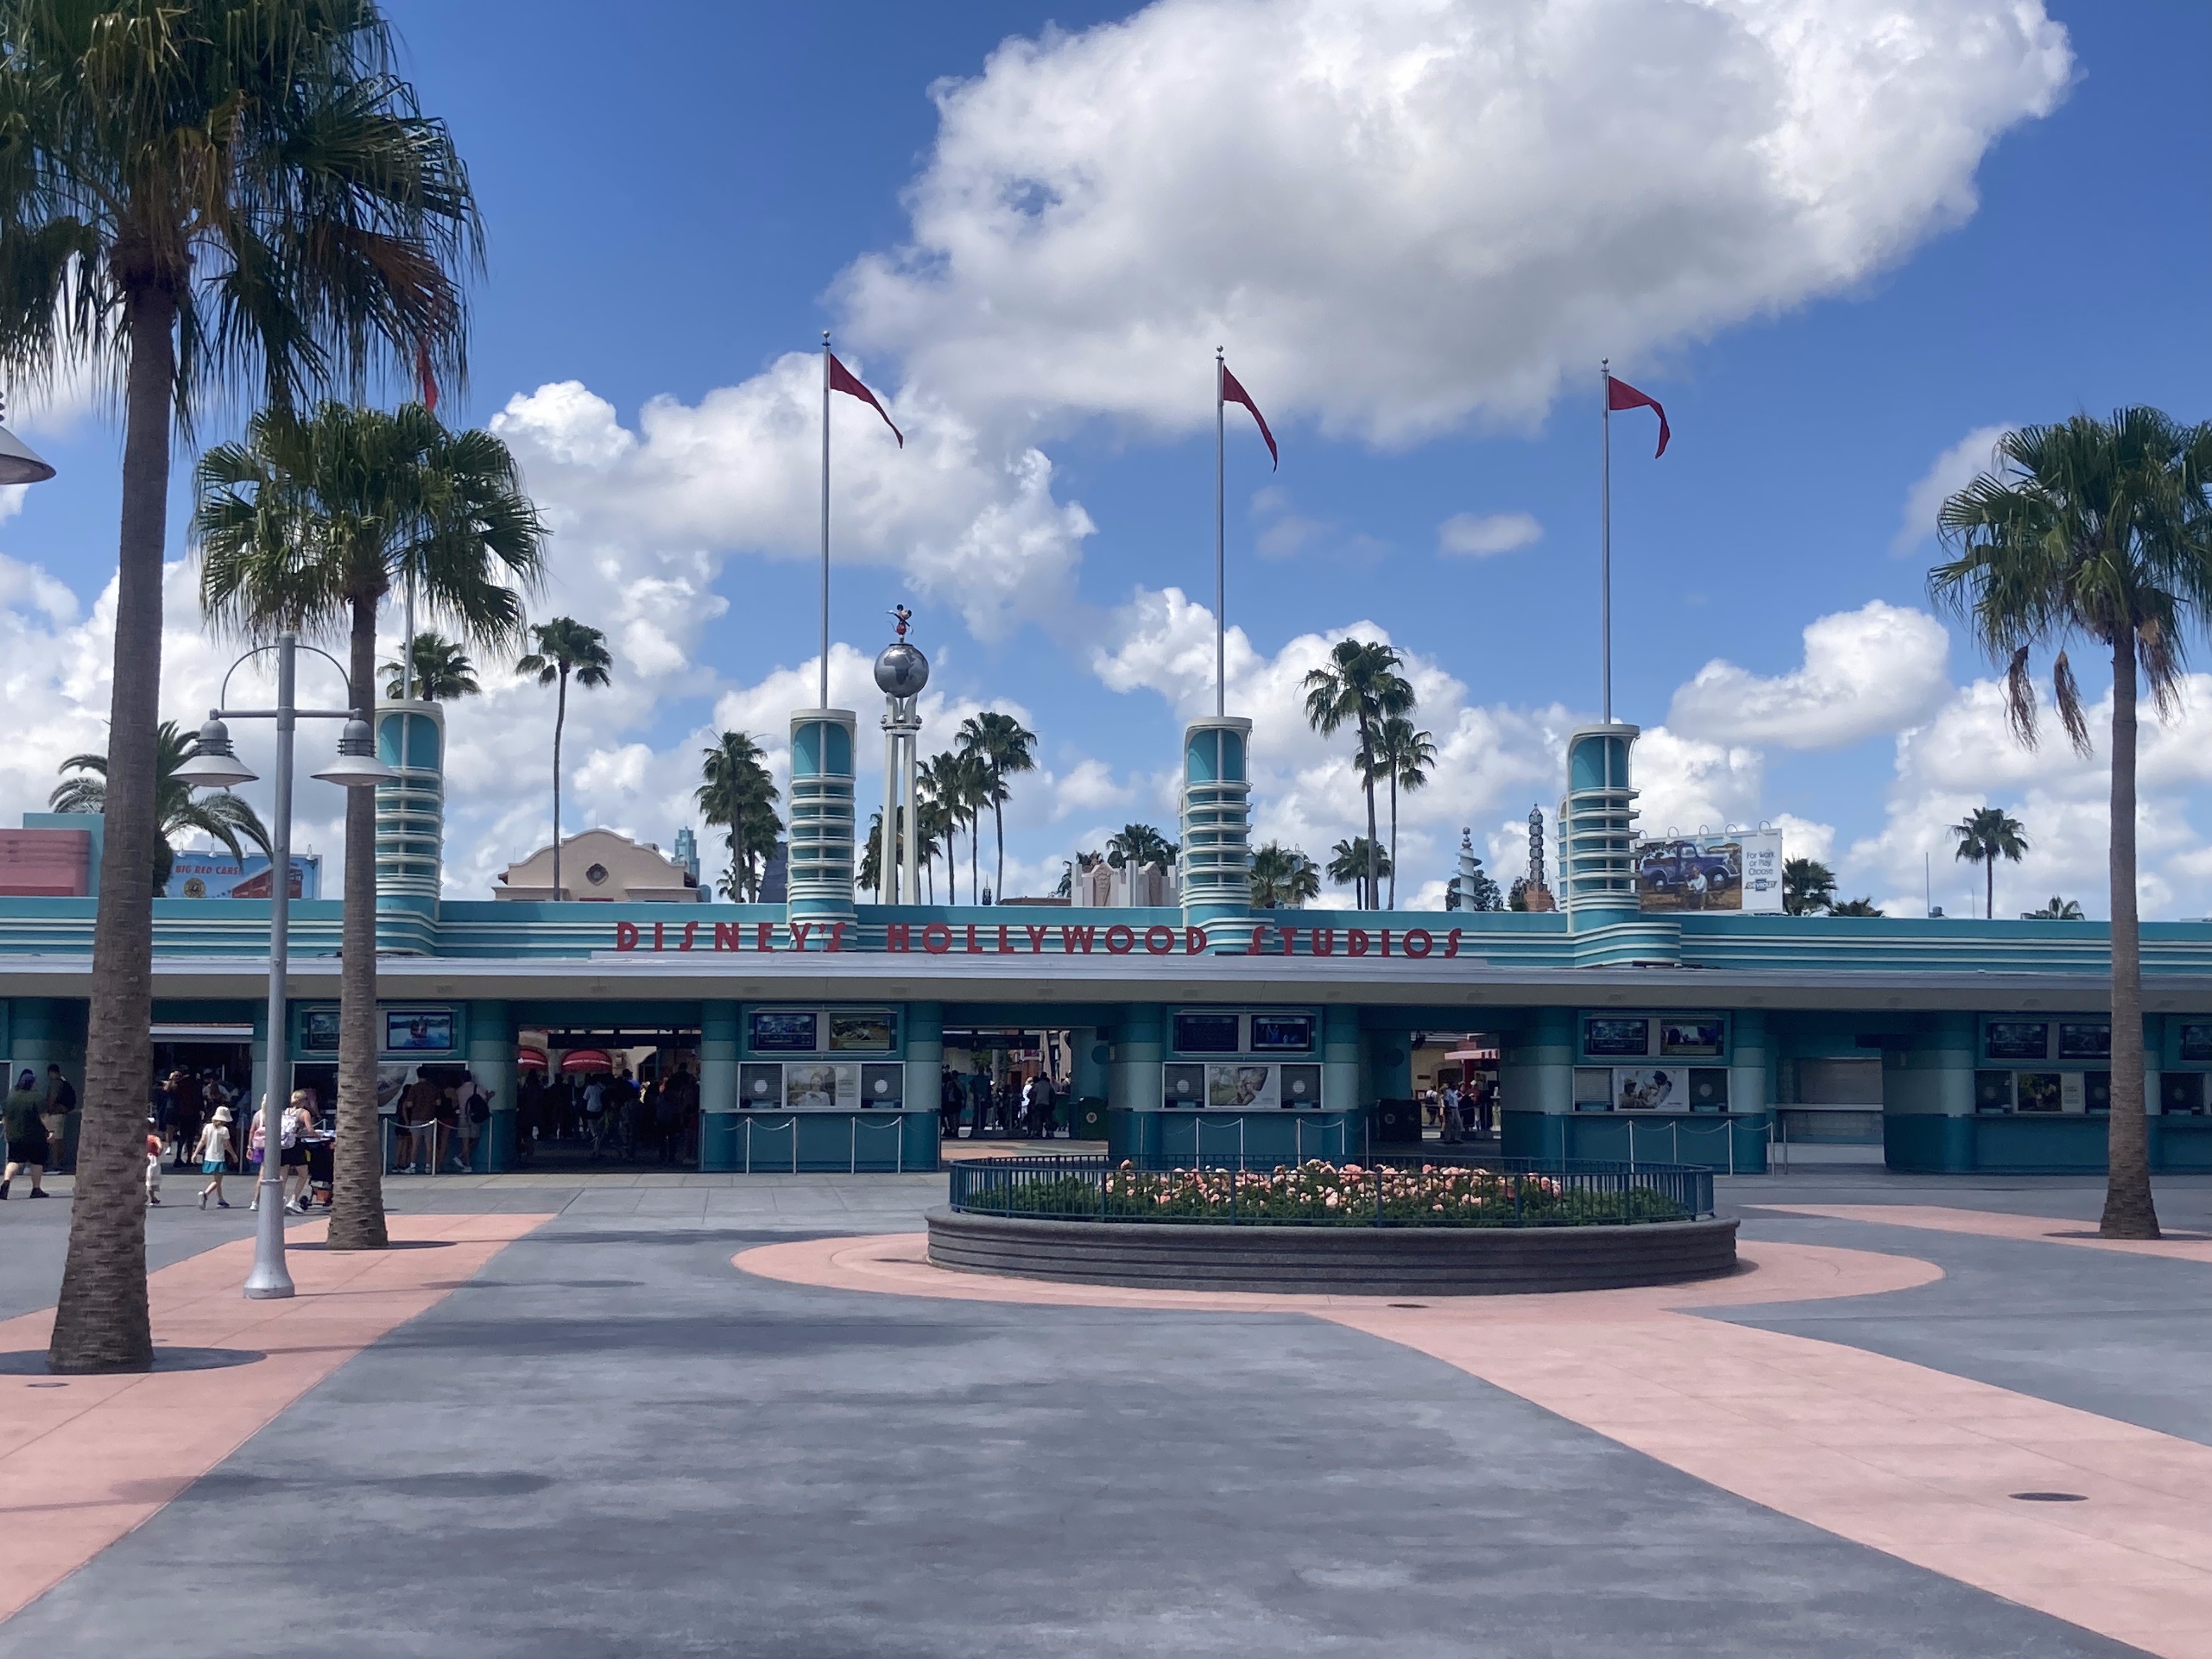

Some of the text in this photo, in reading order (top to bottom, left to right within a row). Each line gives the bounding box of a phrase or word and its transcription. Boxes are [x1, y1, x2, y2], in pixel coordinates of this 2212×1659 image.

[175, 865, 191, 874] BIG
[194, 866, 212, 874] RED
[616, 921, 1461, 959] DISNEY'S HOLLYWOOD STUDIOS
